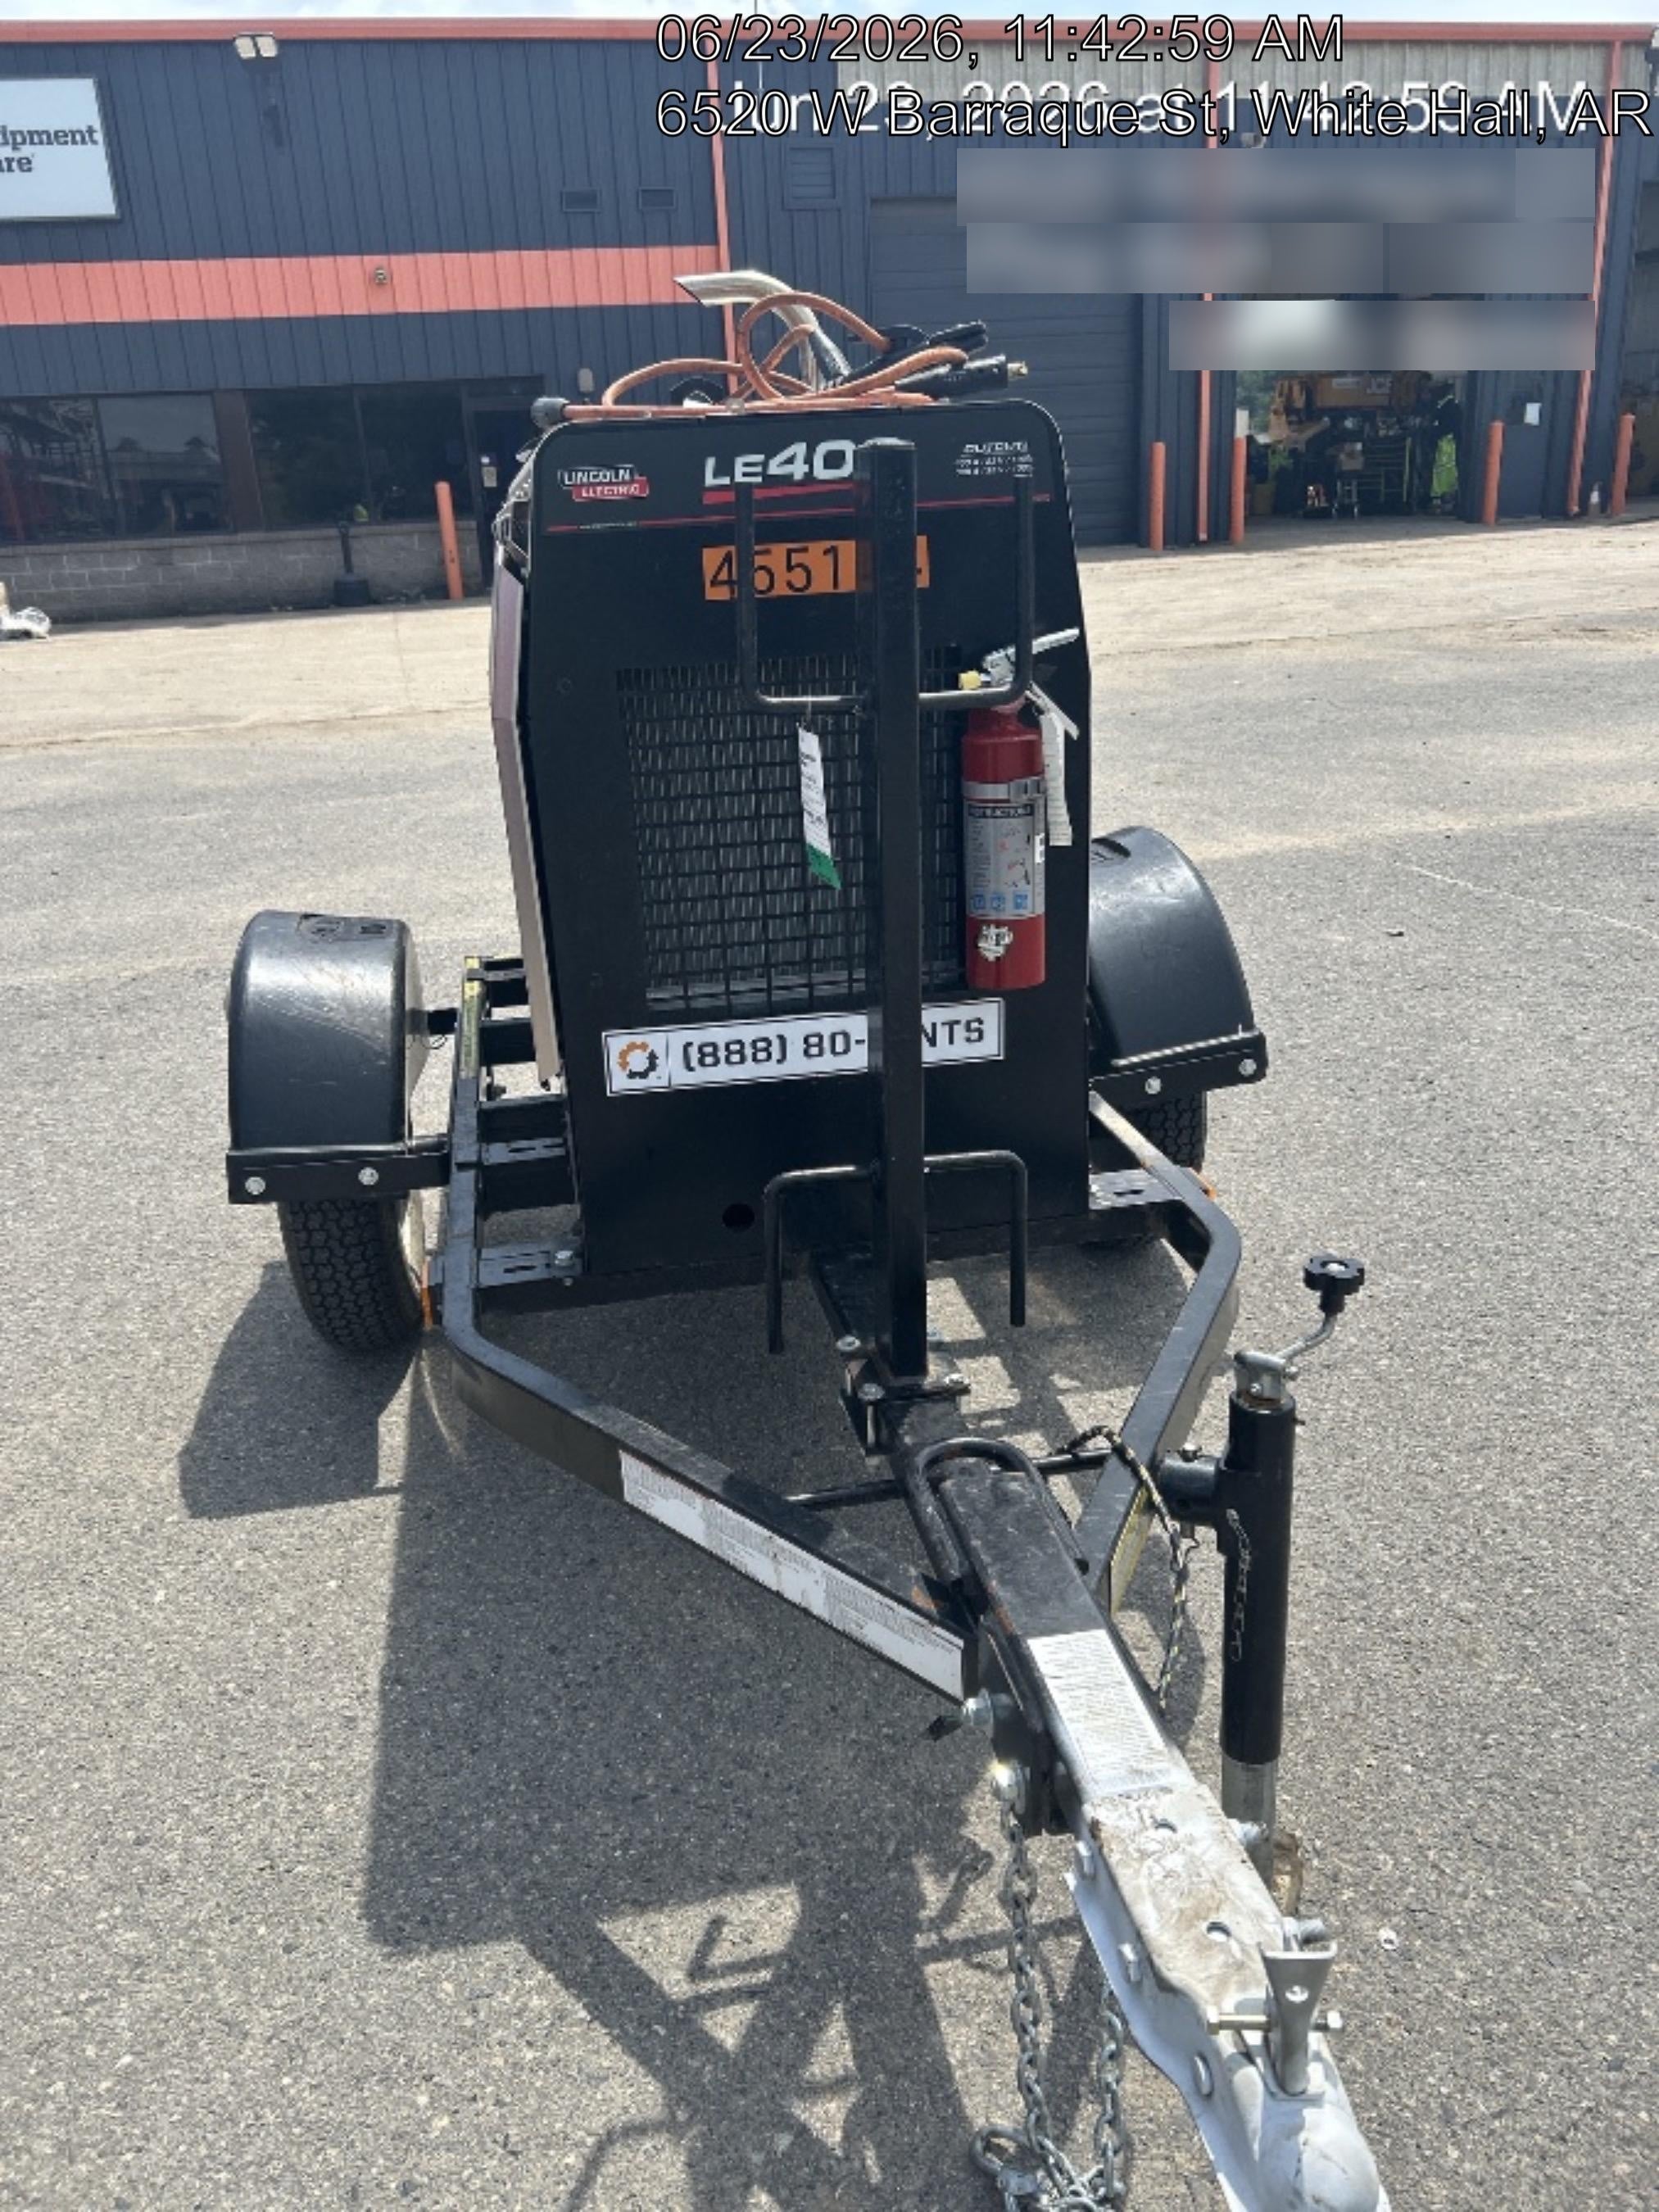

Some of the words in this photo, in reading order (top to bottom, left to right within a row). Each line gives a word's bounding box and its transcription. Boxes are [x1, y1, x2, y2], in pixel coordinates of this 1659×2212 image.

[564, 469, 631, 485] LINCOLN
[709, 544, 921, 598] 4551
[682, 1034, 787, 1072] (888)
